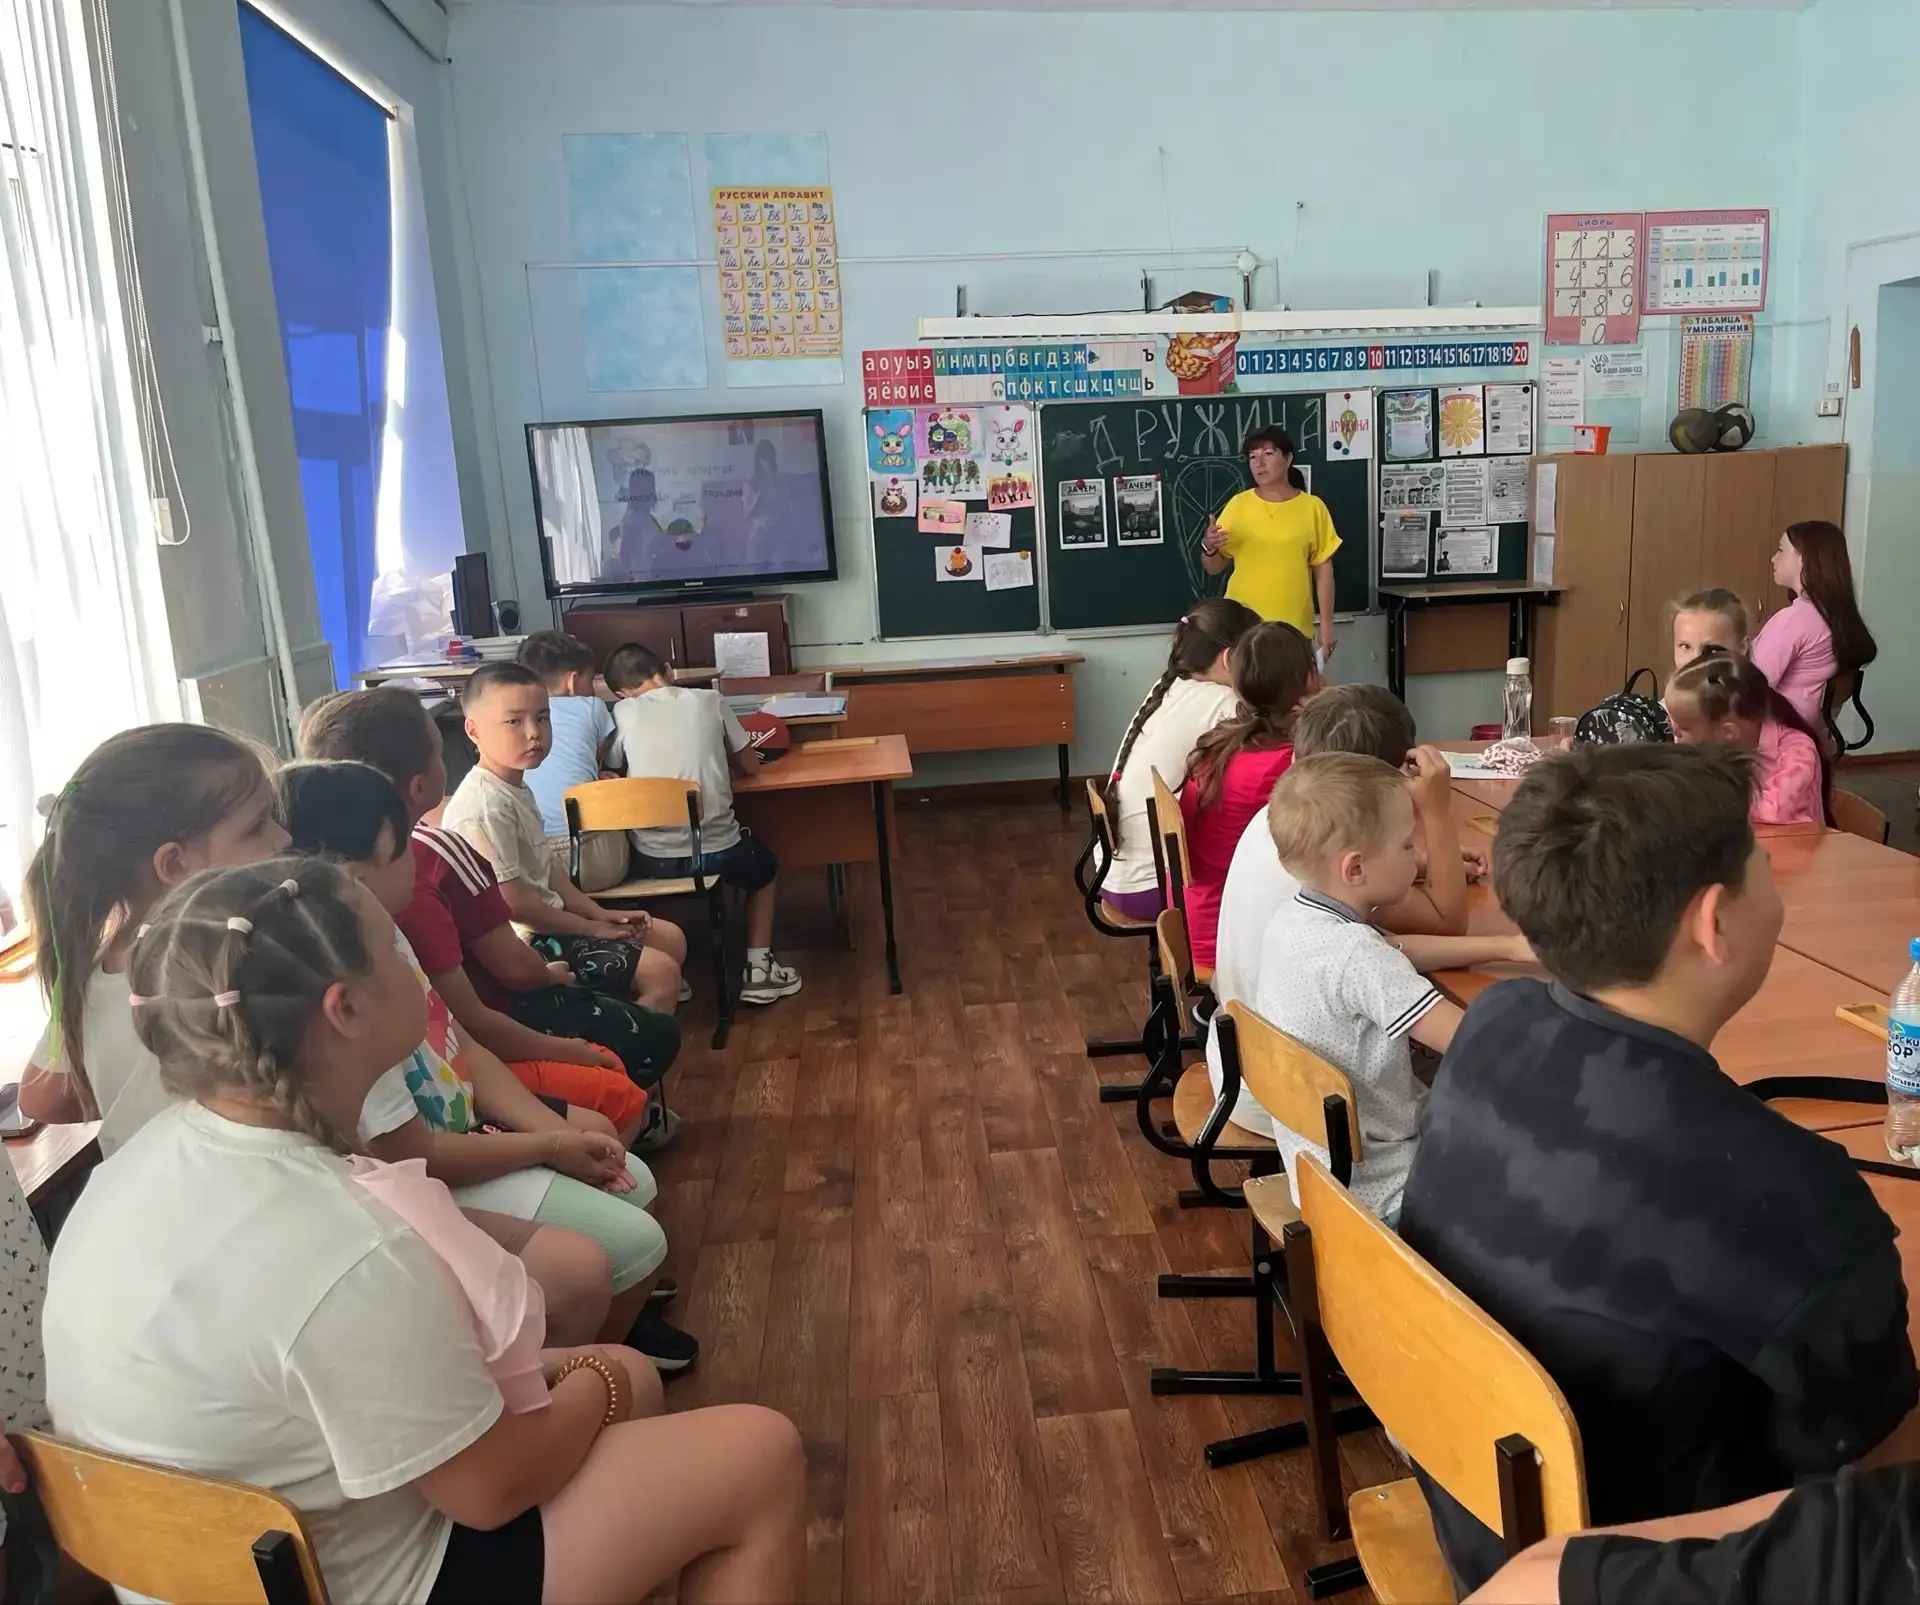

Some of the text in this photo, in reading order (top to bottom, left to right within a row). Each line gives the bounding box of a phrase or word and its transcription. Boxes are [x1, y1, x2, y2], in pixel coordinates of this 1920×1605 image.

[773, 191, 824, 199] АЛФАВИТ
[1572, 236, 1635, 259] 1 2 3
[1570, 266, 1633, 287] 4 5 6
[1569, 294, 1633, 316] 7 8 9
[1687, 325, 1748, 333] УМНОЖЕНИЯ
[1696, 316, 1740, 324] ТАБЛИЦА
[1593, 323, 1606, 345] 0
[1239, 355, 1246, 371] 0
[1252, 355, 1258, 370] 1
[1266, 354, 1273, 370] 2
[1280, 354, 1286, 369] 3
[1292, 353, 1300, 369] 4
[1306, 353, 1312, 369] 5
[1319, 352, 1326, 368] 6
[1332, 352, 1339, 368] 7
[1345, 352, 1352, 367] 8
[1358, 351, 1366, 366] 9
[1370, 351, 1382, 366] 10
[1385, 350, 1396, 366] 11
[1400, 350, 1411, 365] 12
[1415, 349, 1426, 364] 13
[1429, 348, 1441, 364] 14
[1444, 348, 1455, 364] 15
[1458, 348, 1470, 363] 16
[1472, 347, 1484, 363] 17
[1487, 347, 1499, 362] 18
[1502, 346, 1513, 362] 19
[1515, 346, 1527, 362] 20
